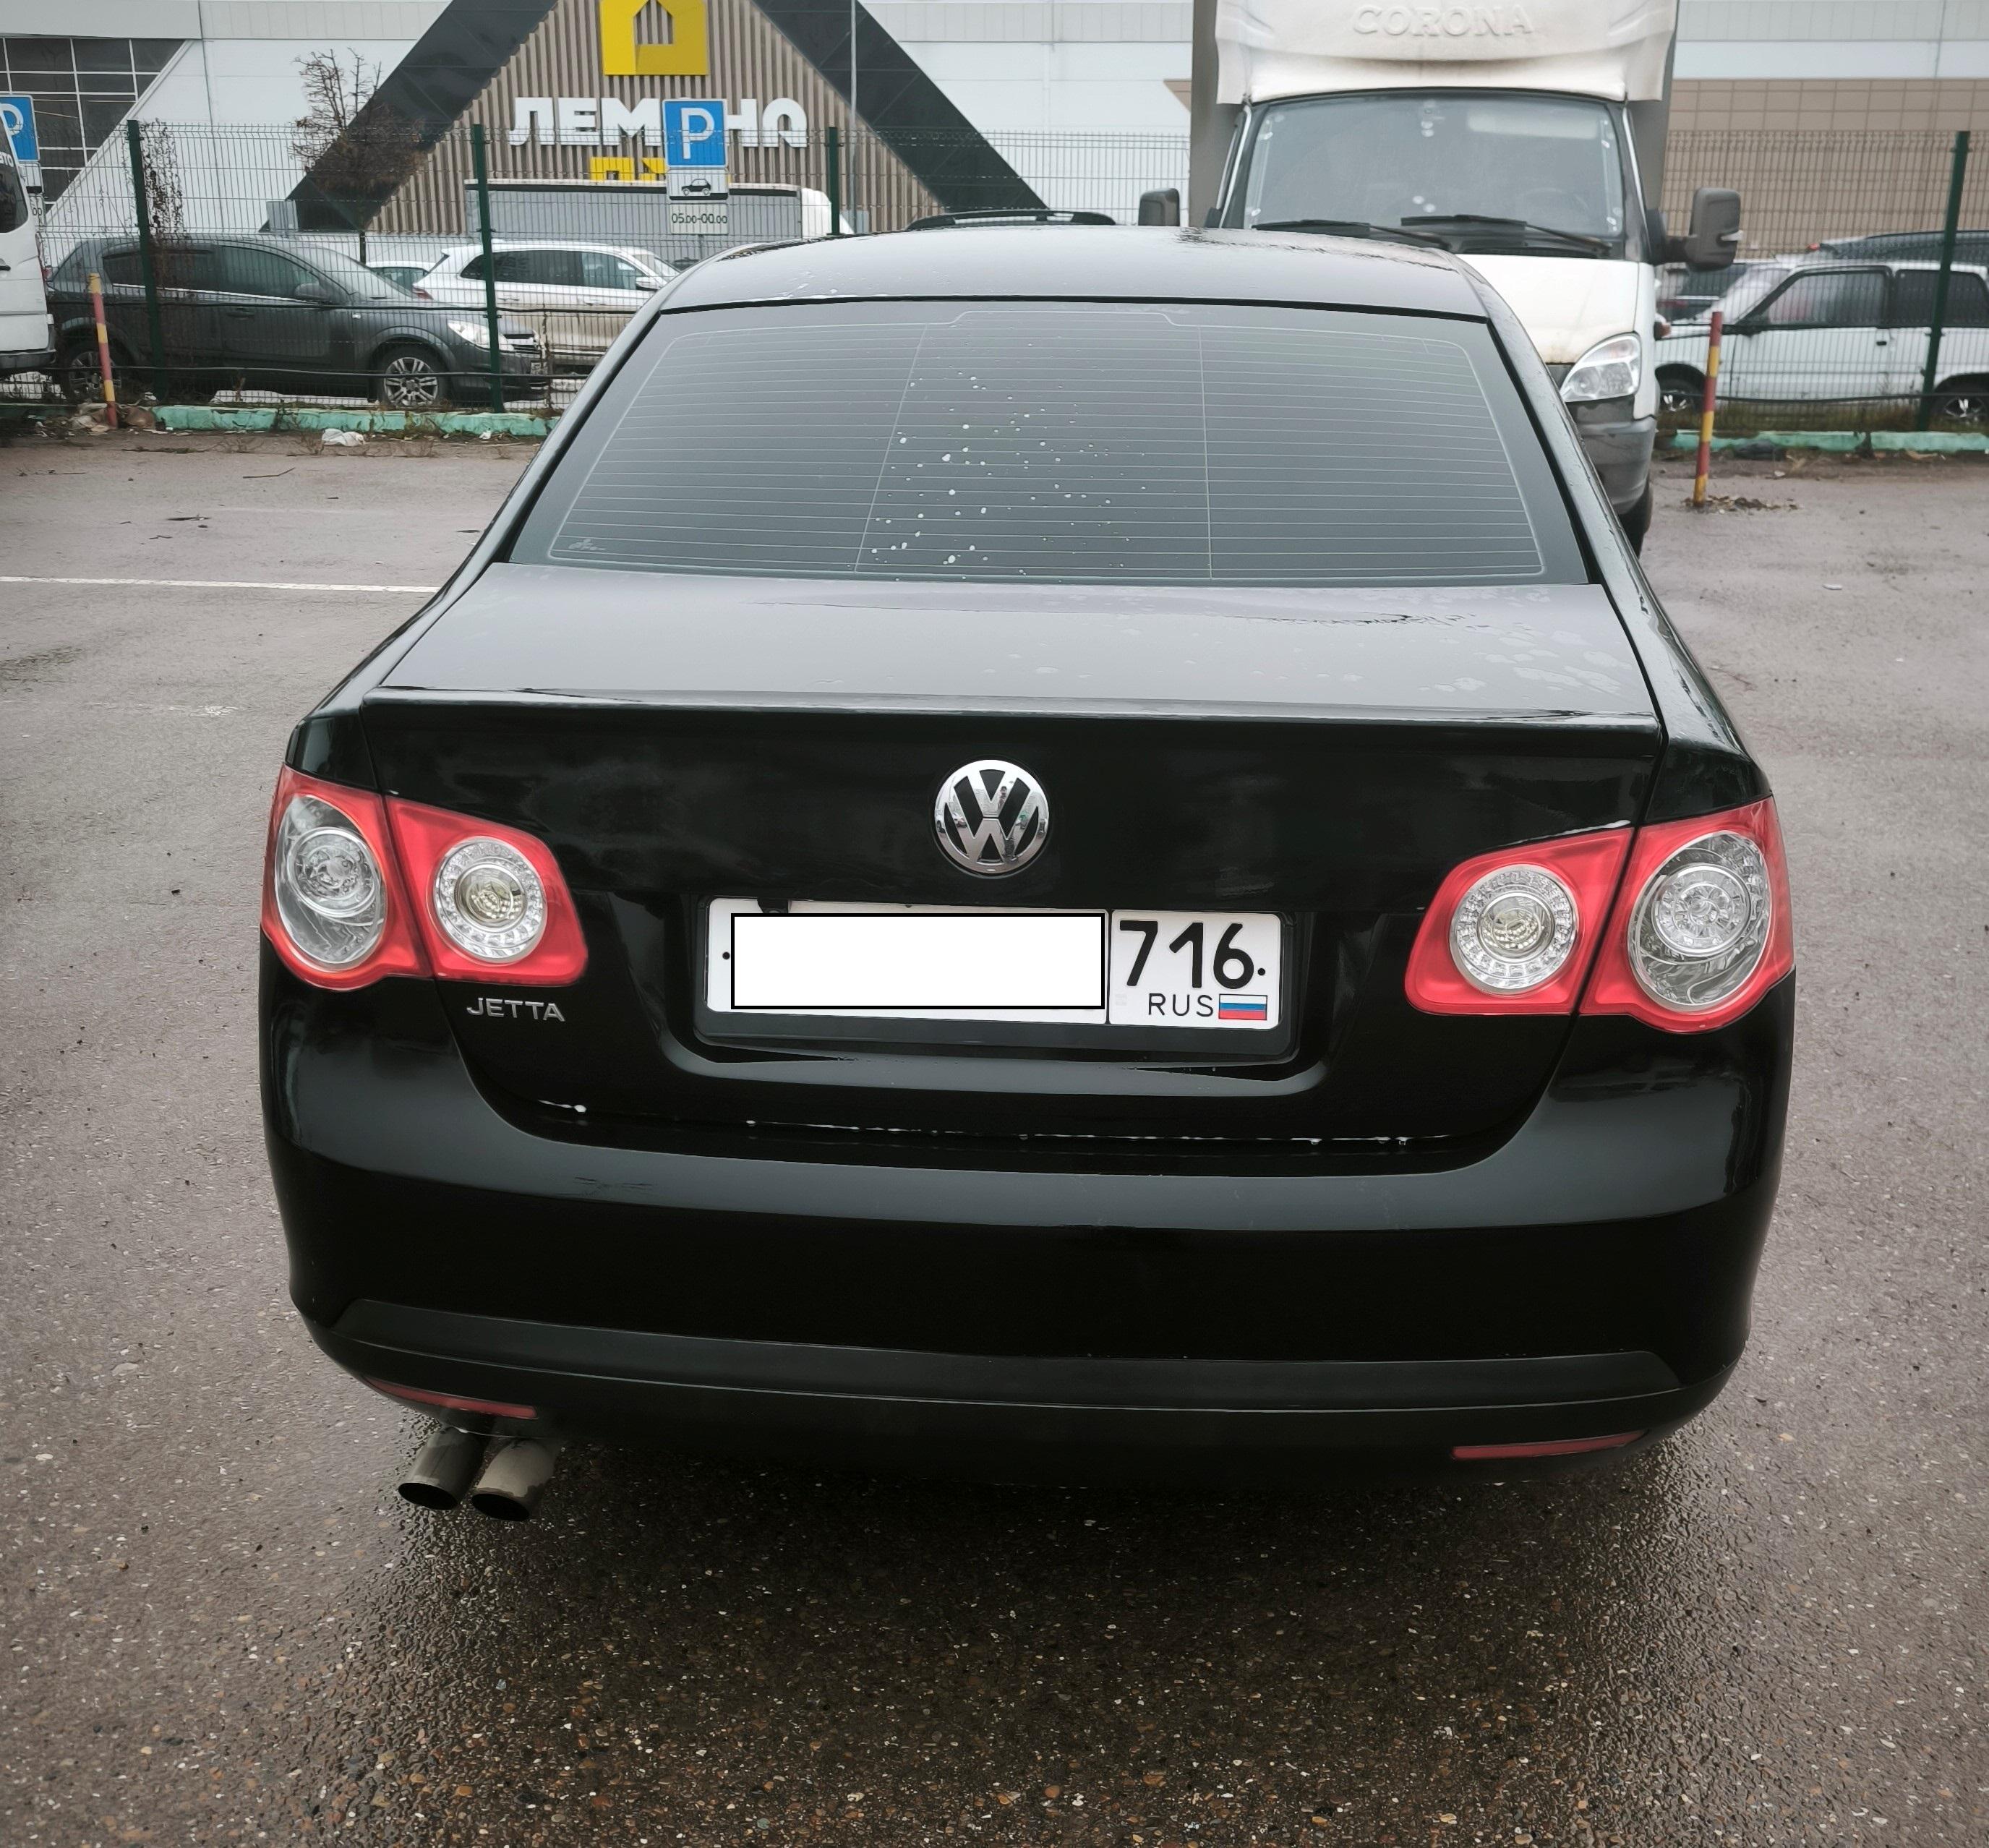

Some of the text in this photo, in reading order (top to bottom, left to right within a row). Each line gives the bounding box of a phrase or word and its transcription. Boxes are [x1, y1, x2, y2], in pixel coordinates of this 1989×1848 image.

[1352, 4, 1534, 36] CORONA
[509, 97, 808, 147] ЛЕМНА
[680, 107, 715, 160] P
[1119, 920, 1254, 990] 716
[466, 997, 565, 1022] JETTA
[1148, 993, 1214, 1017] RUS
